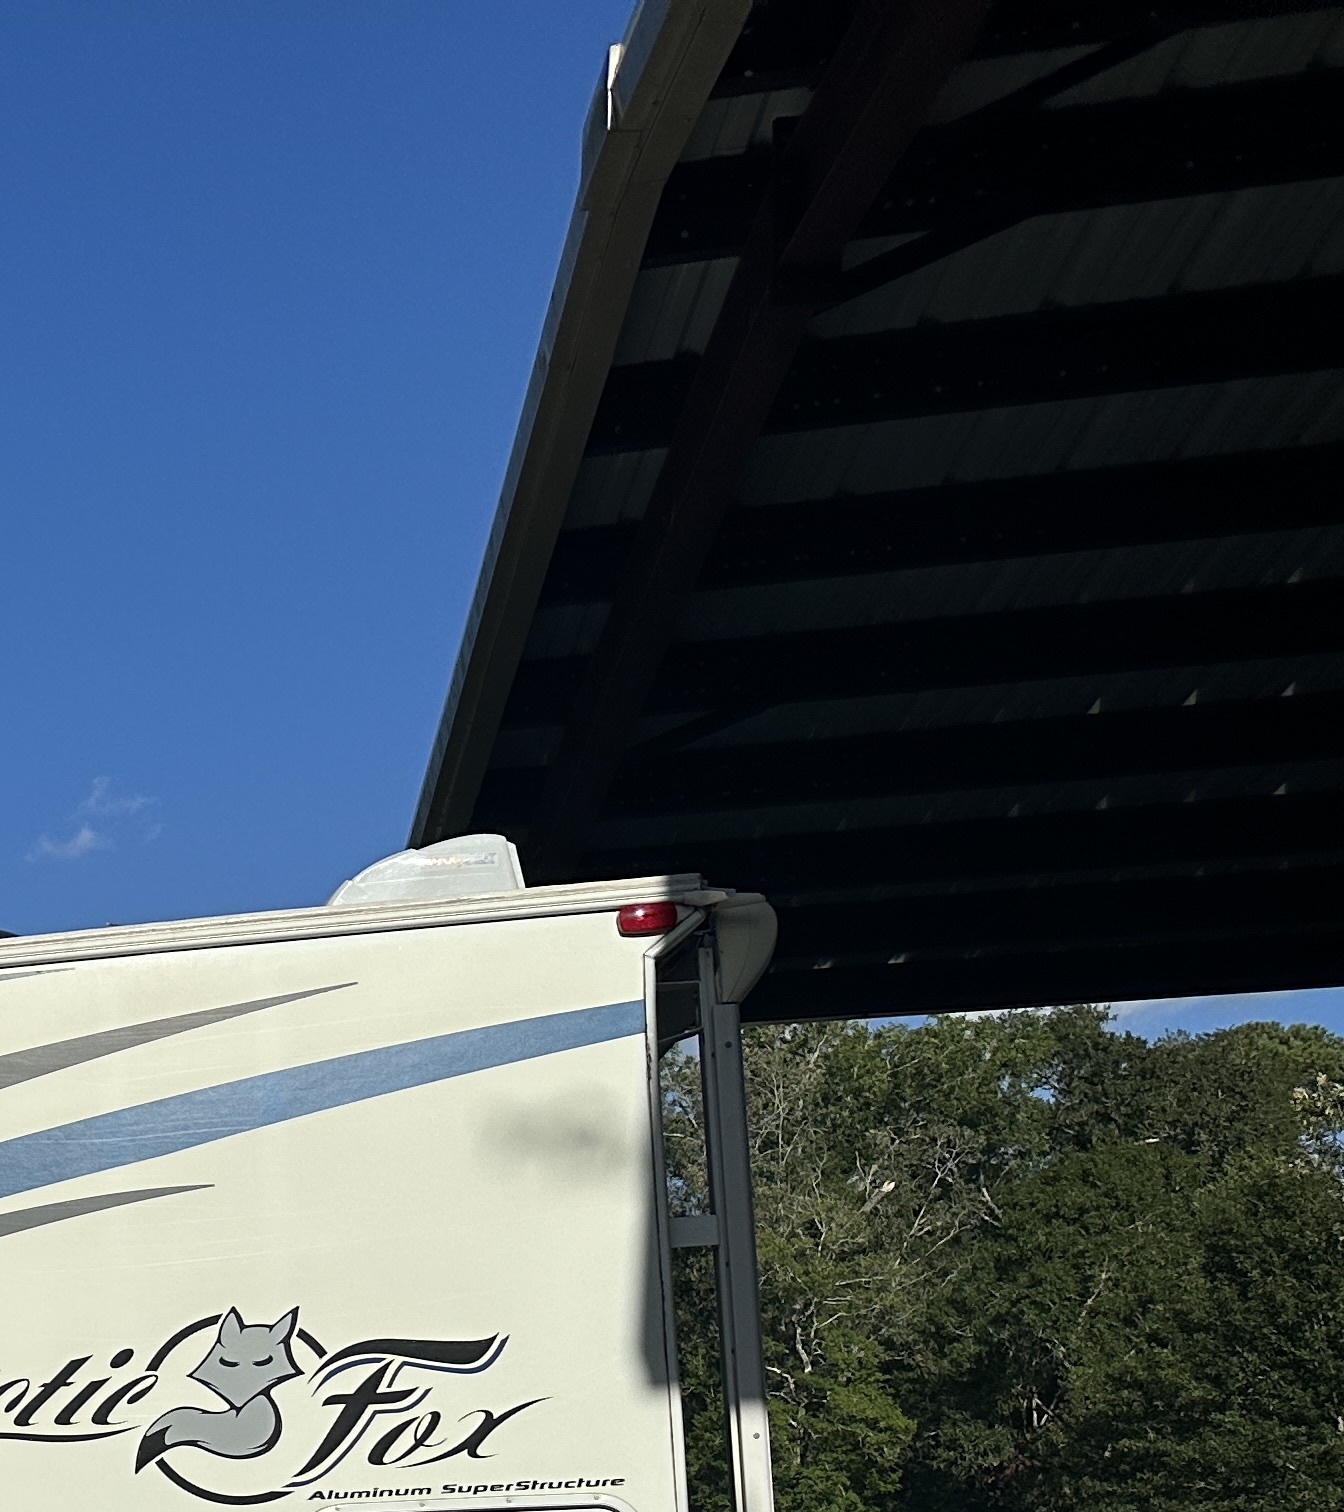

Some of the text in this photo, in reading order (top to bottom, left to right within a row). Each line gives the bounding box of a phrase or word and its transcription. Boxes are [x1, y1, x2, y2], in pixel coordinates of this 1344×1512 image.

[280, 1332, 553, 1490] Fox
[307, 1477, 626, 1501] Aluminum SuperStructure
